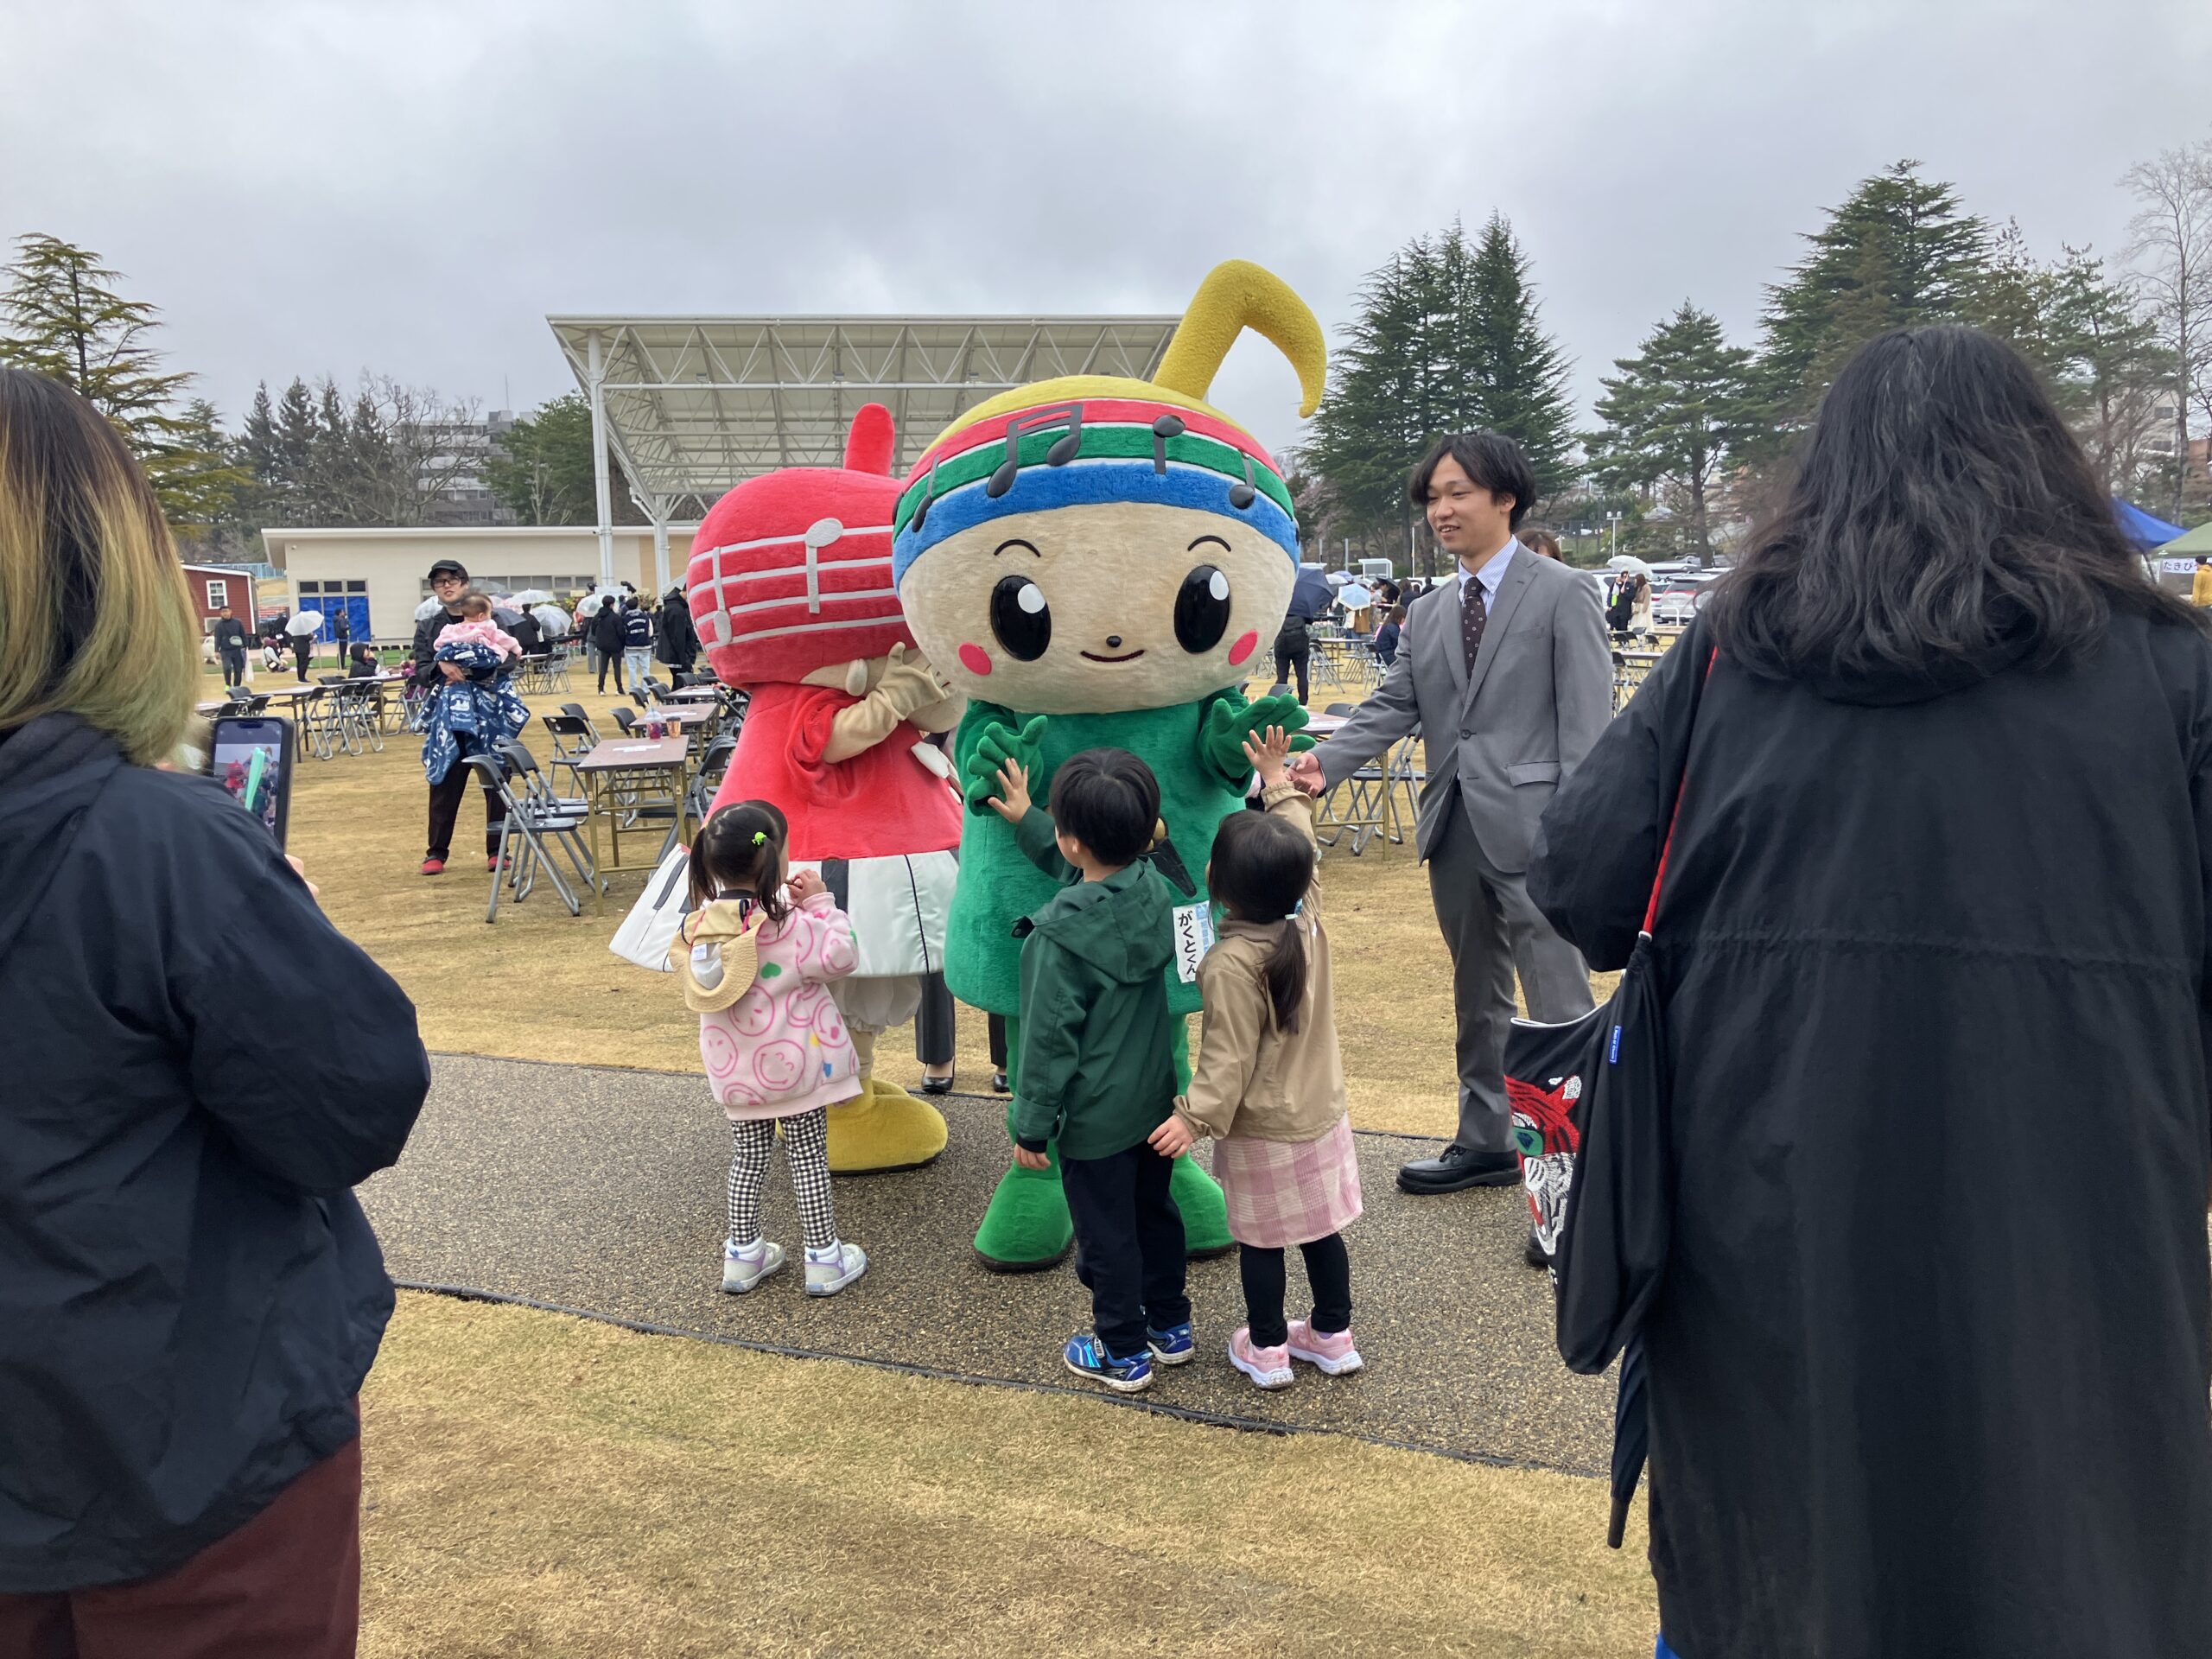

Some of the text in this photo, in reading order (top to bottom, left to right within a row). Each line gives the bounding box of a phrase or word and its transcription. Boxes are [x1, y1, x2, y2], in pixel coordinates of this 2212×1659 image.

[1178, 910, 1197, 976] がくとくん
